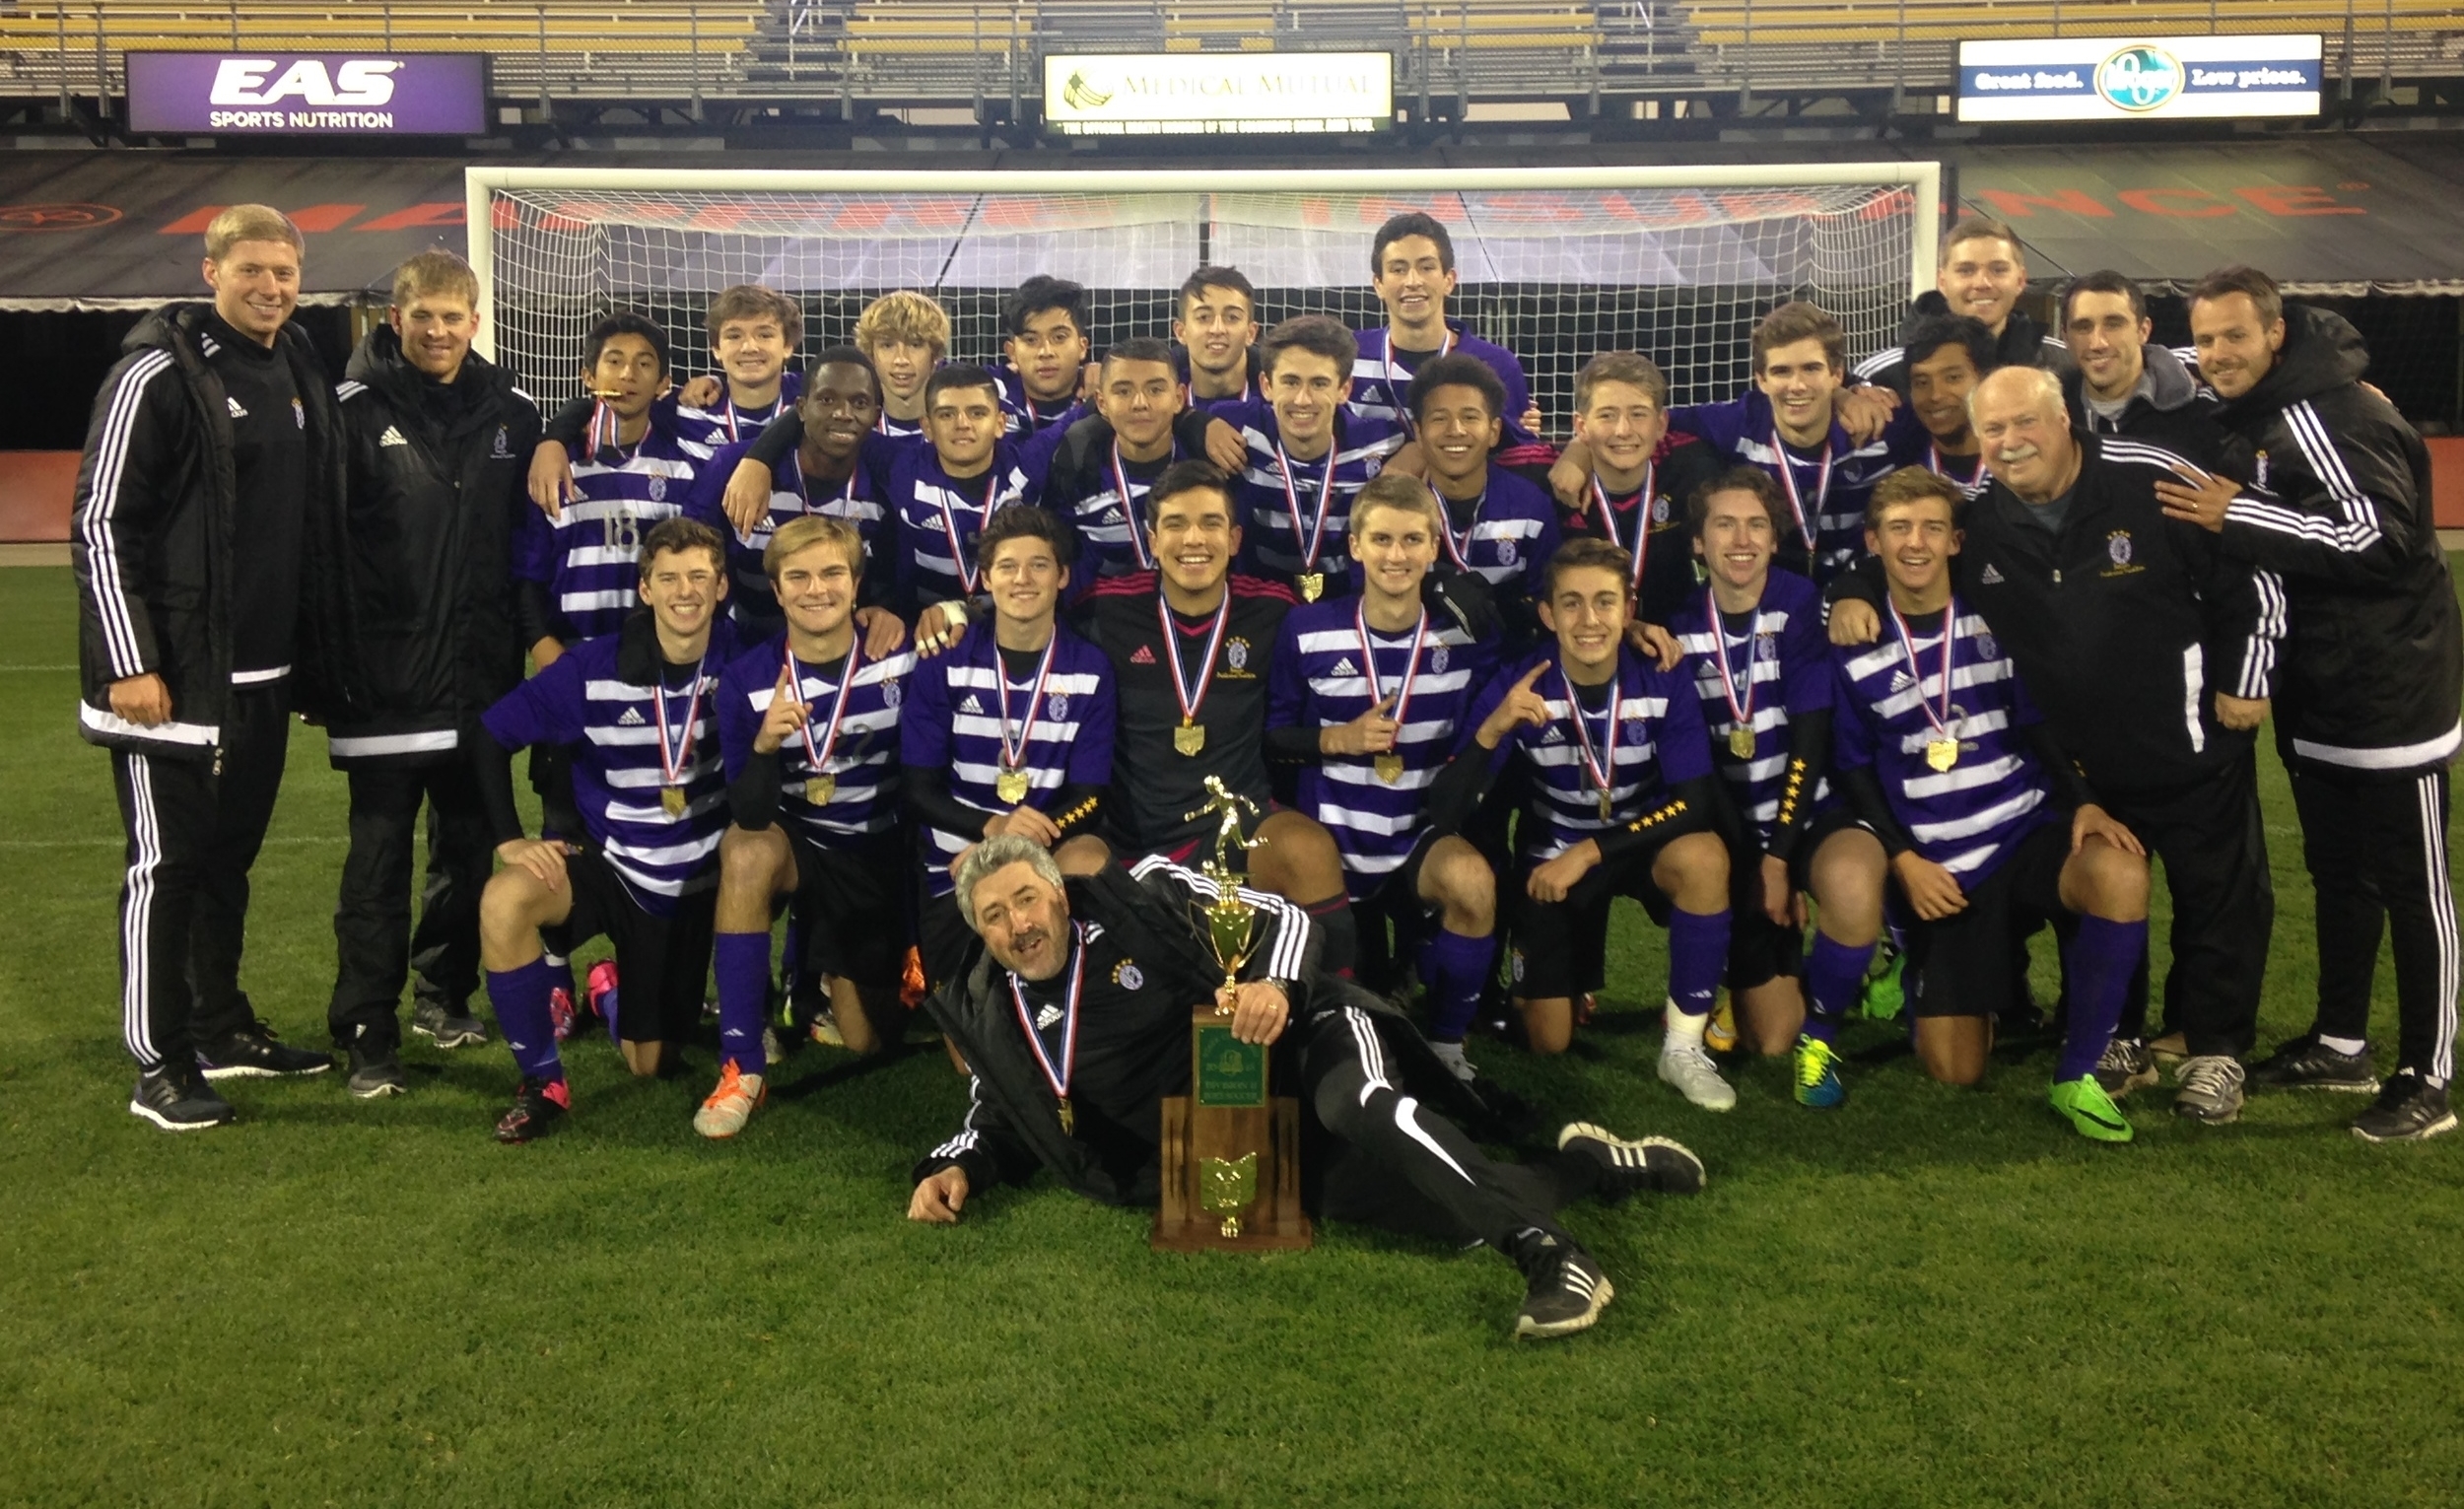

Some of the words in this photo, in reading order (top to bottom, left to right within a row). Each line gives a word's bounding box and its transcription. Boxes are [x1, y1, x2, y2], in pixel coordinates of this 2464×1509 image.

[209, 59, 398, 105] EAS
[1124, 73, 1244, 96] MEDICAL
[1260, 72, 1374, 96] MUTUAL
[1975, 72, 2031, 90] Great
[2034, 71, 2085, 89] food.
[2191, 68, 2237, 86] Low
[2238, 67, 2307, 89] prices.
[210, 110, 285, 128] SPORTS
[289, 111, 393, 128] NUTRITION
[602, 509, 641, 554] 18
